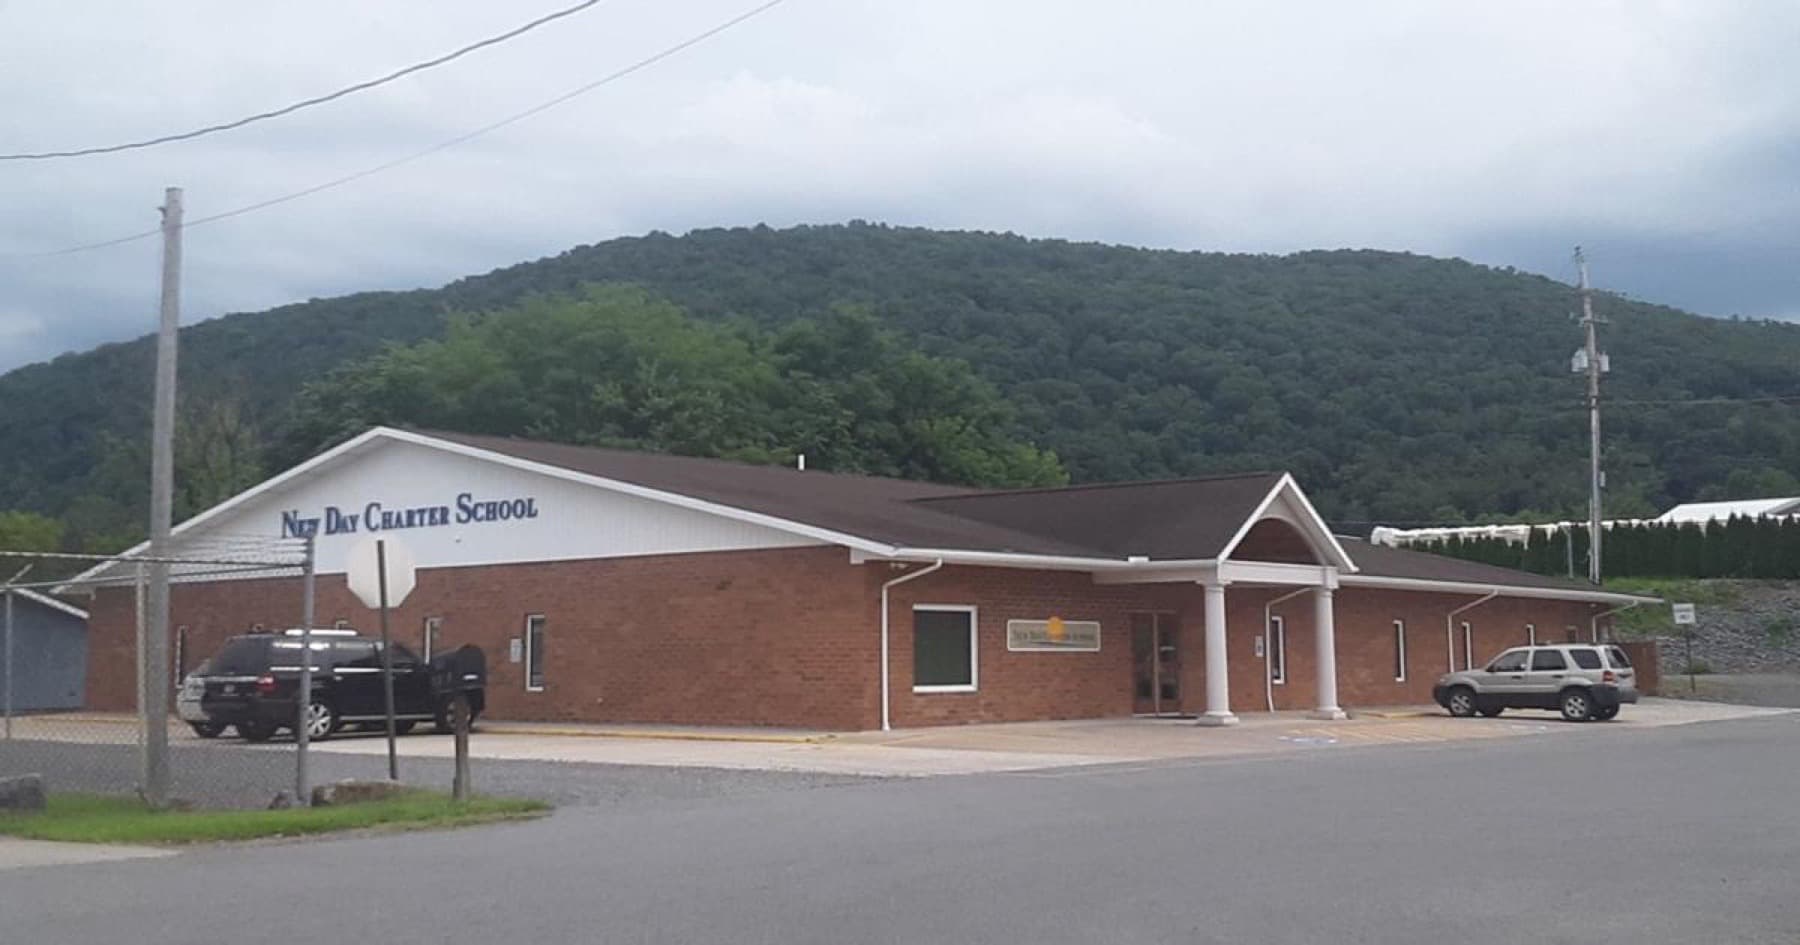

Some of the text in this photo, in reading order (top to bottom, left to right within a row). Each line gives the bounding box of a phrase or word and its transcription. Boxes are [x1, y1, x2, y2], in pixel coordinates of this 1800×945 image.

[324, 506, 360, 535] DAY
[365, 502, 450, 532] CHARTER
[456, 493, 538, 524] SCHOOL
